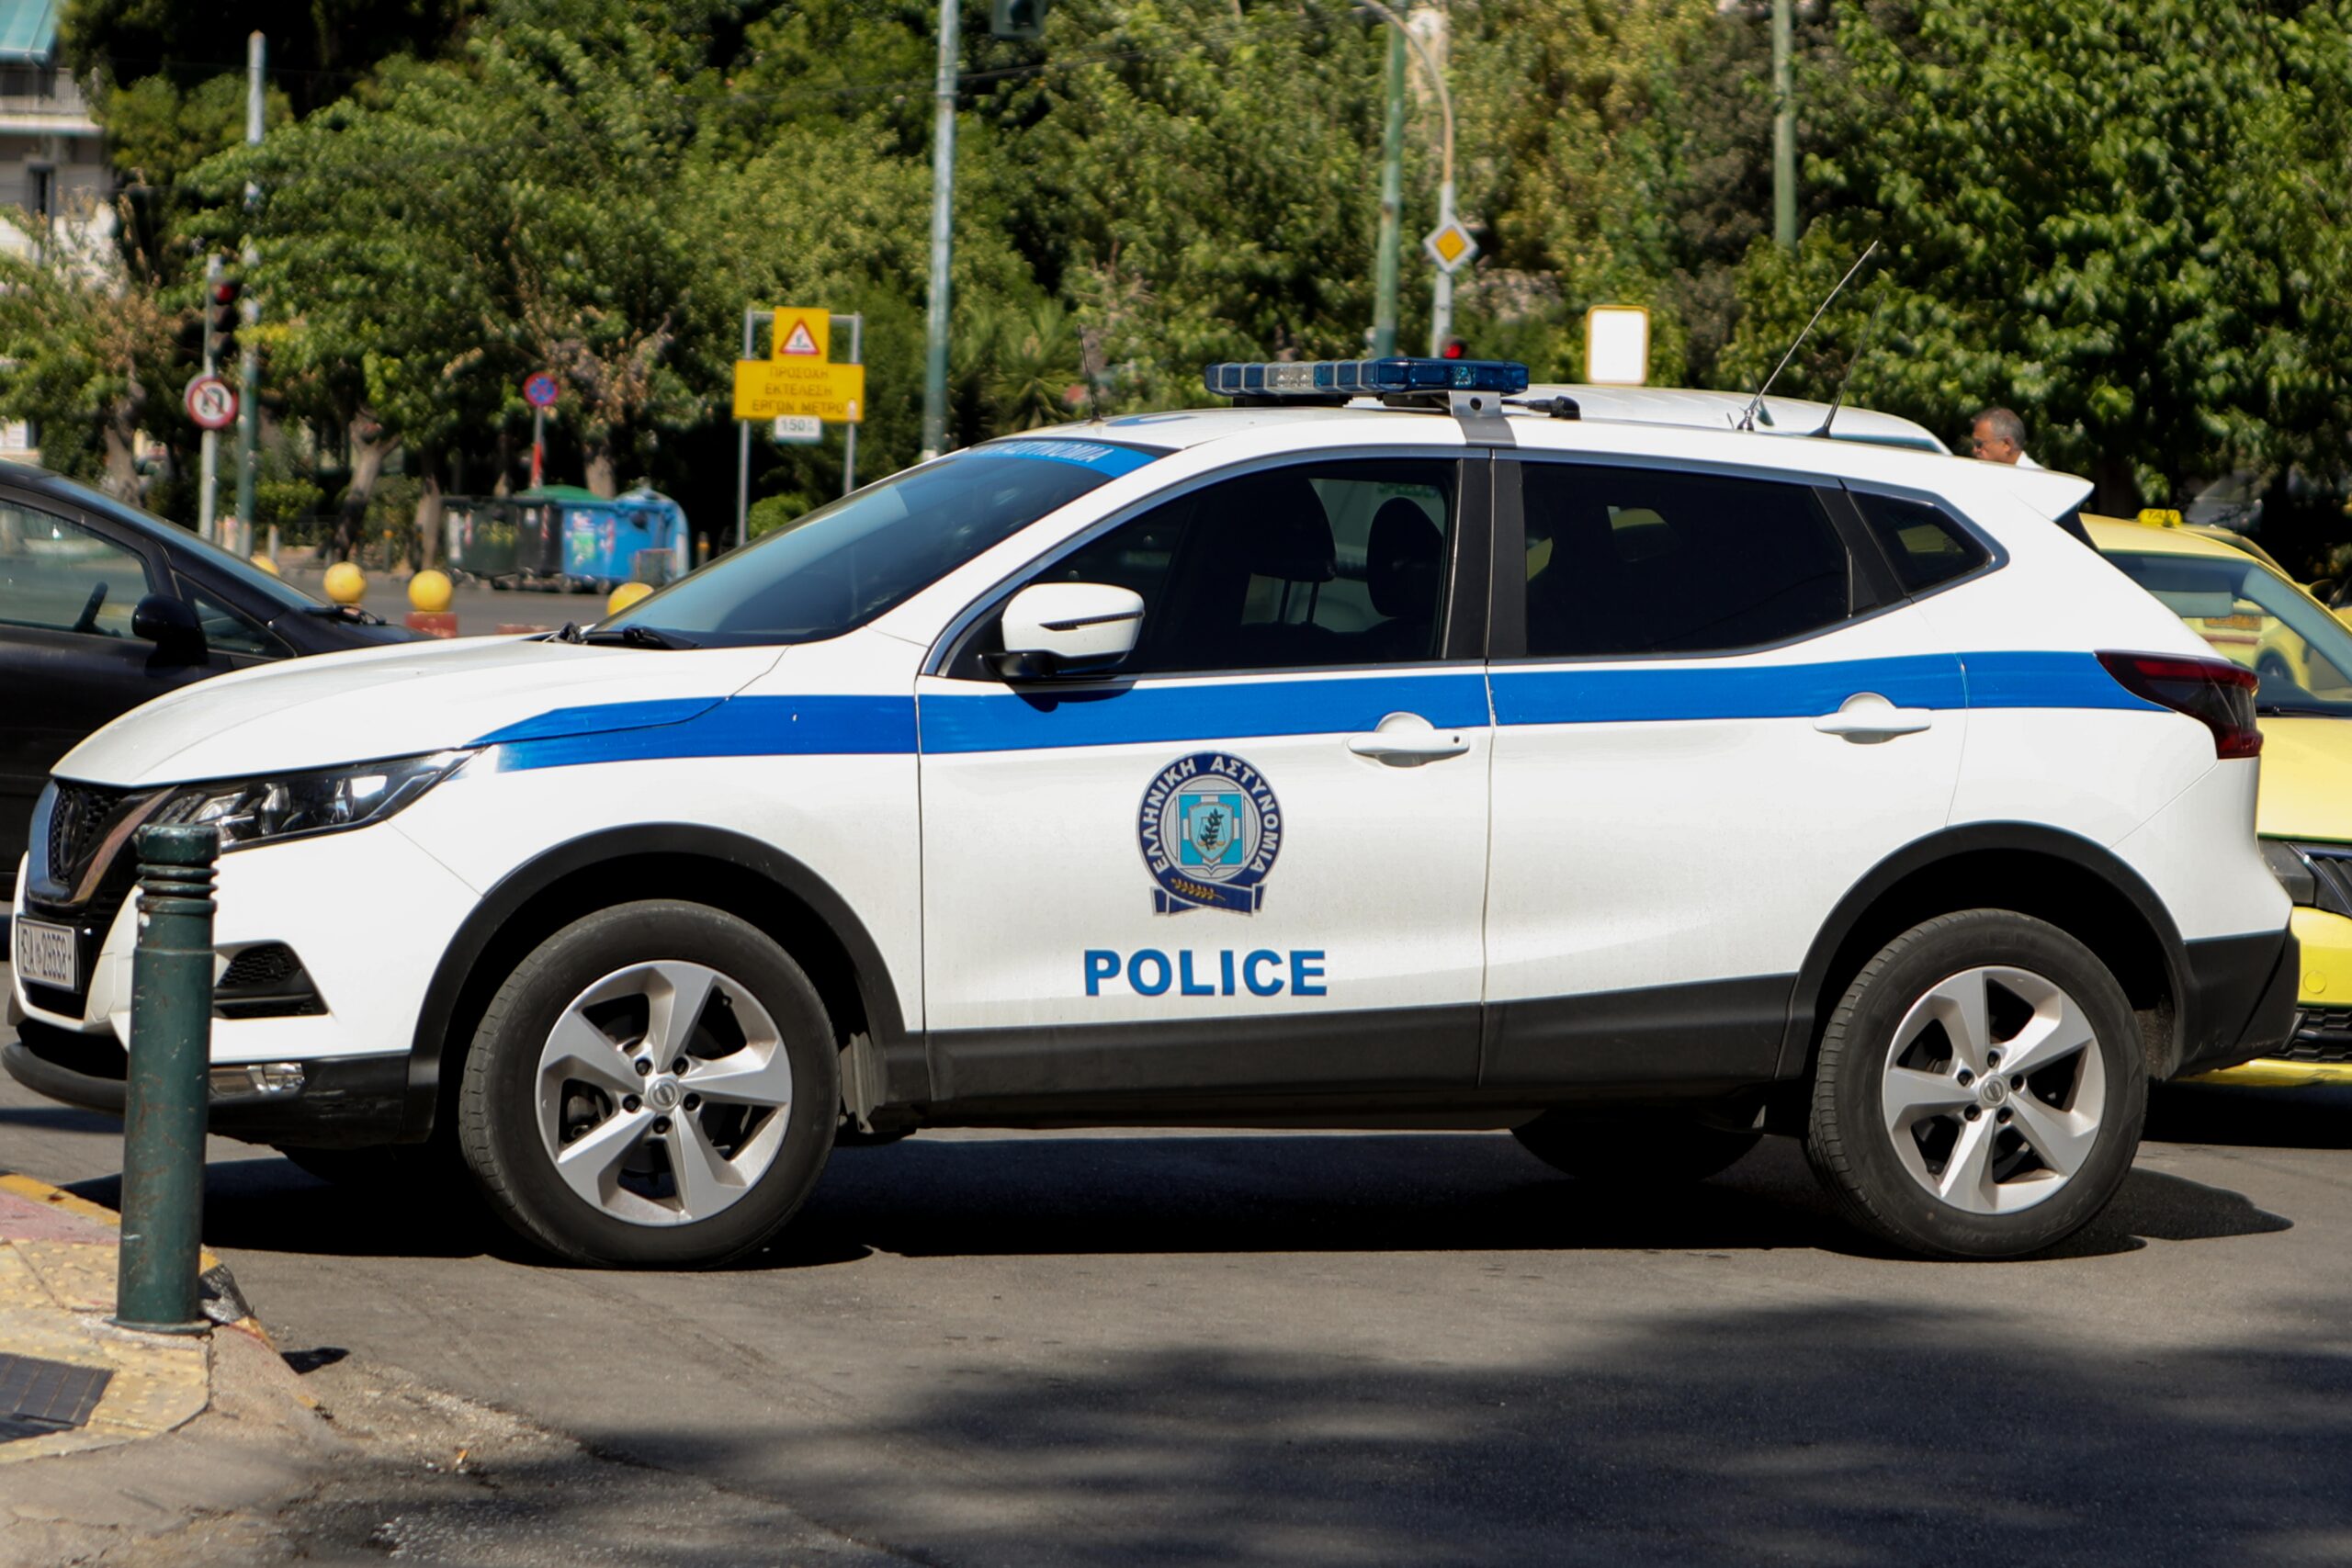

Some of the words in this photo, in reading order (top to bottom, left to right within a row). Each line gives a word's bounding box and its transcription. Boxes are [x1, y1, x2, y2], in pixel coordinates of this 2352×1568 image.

[770, 367, 829, 378] ΠΡΟΣΟΧΗ
[764, 383, 832, 396] ΕΚΤΕΛΕΣΗ
[752, 400, 795, 412] ΕΡΓΩΝ
[801, 402, 844, 414] ΜΕΤΡΟ
[781, 418, 806, 431] 150
[1142, 758, 1197, 874] ΕΛΛΗΝΙΚΗ
[1210, 756, 1279, 874] ΑΣΤΥΝΟΜΙΑ
[1084, 949, 1328, 997] POLICE
